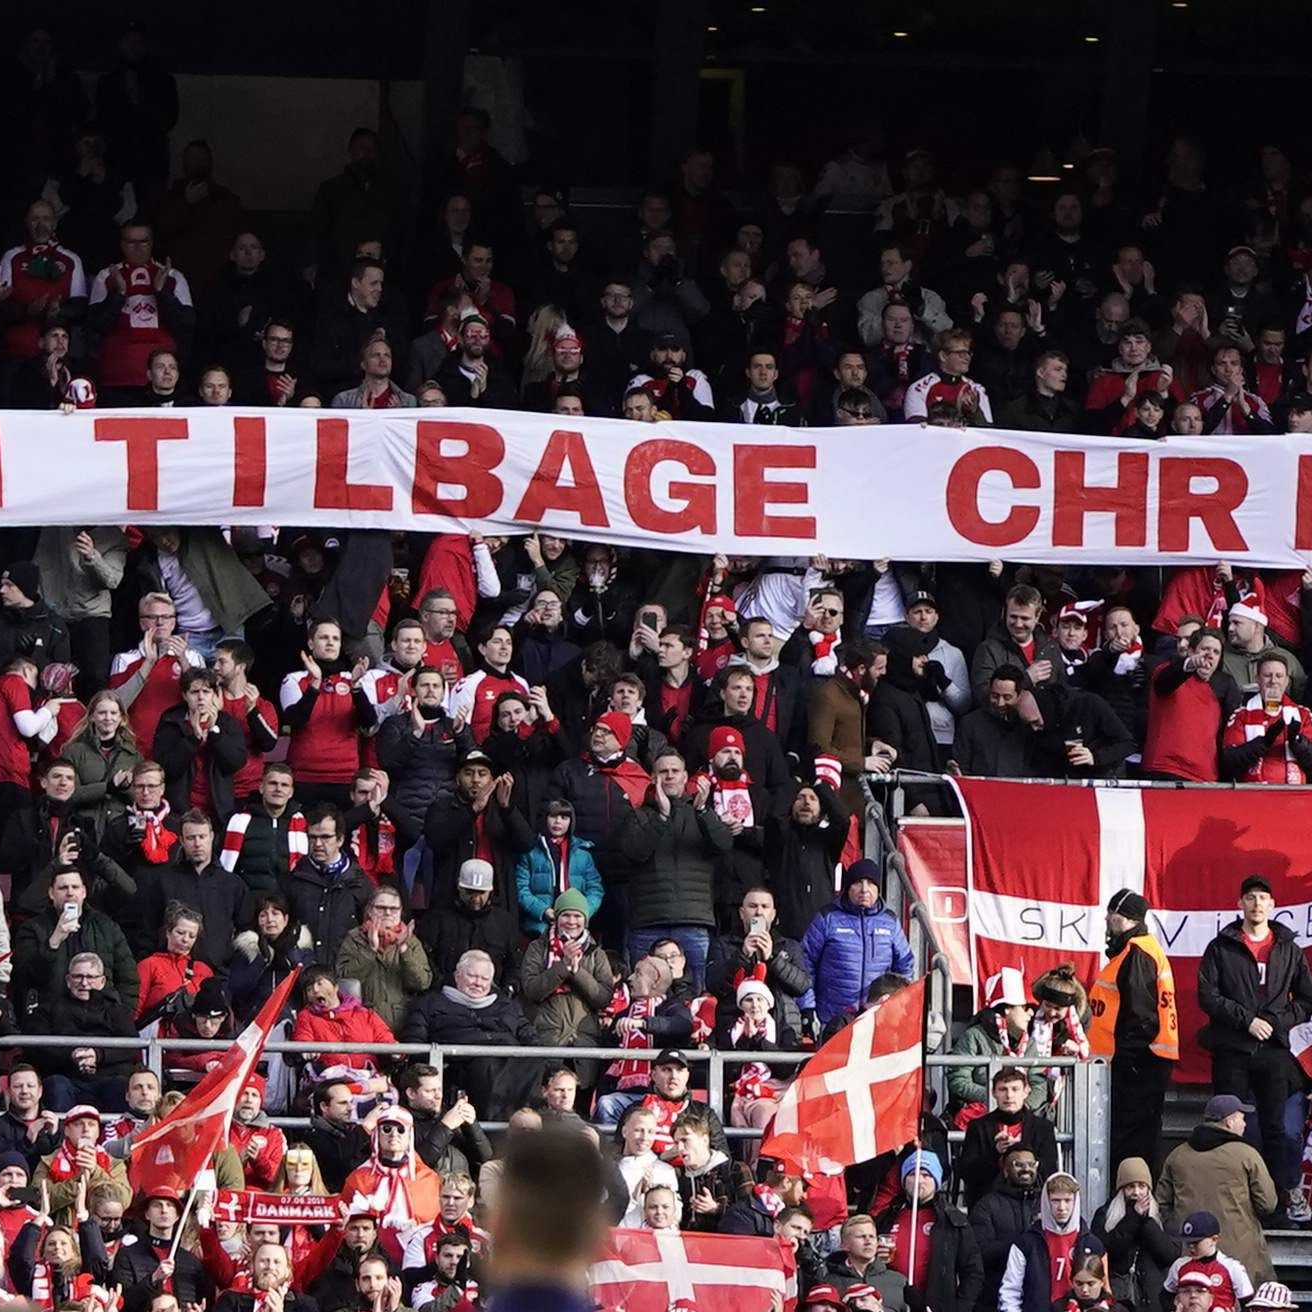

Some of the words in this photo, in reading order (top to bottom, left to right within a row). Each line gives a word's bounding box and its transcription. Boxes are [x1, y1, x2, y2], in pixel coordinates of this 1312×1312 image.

[93, 416, 817, 539] TILBAGE
[255, 1203, 336, 1218] DANMARK
[1056, 1257, 1066, 1281] 7
